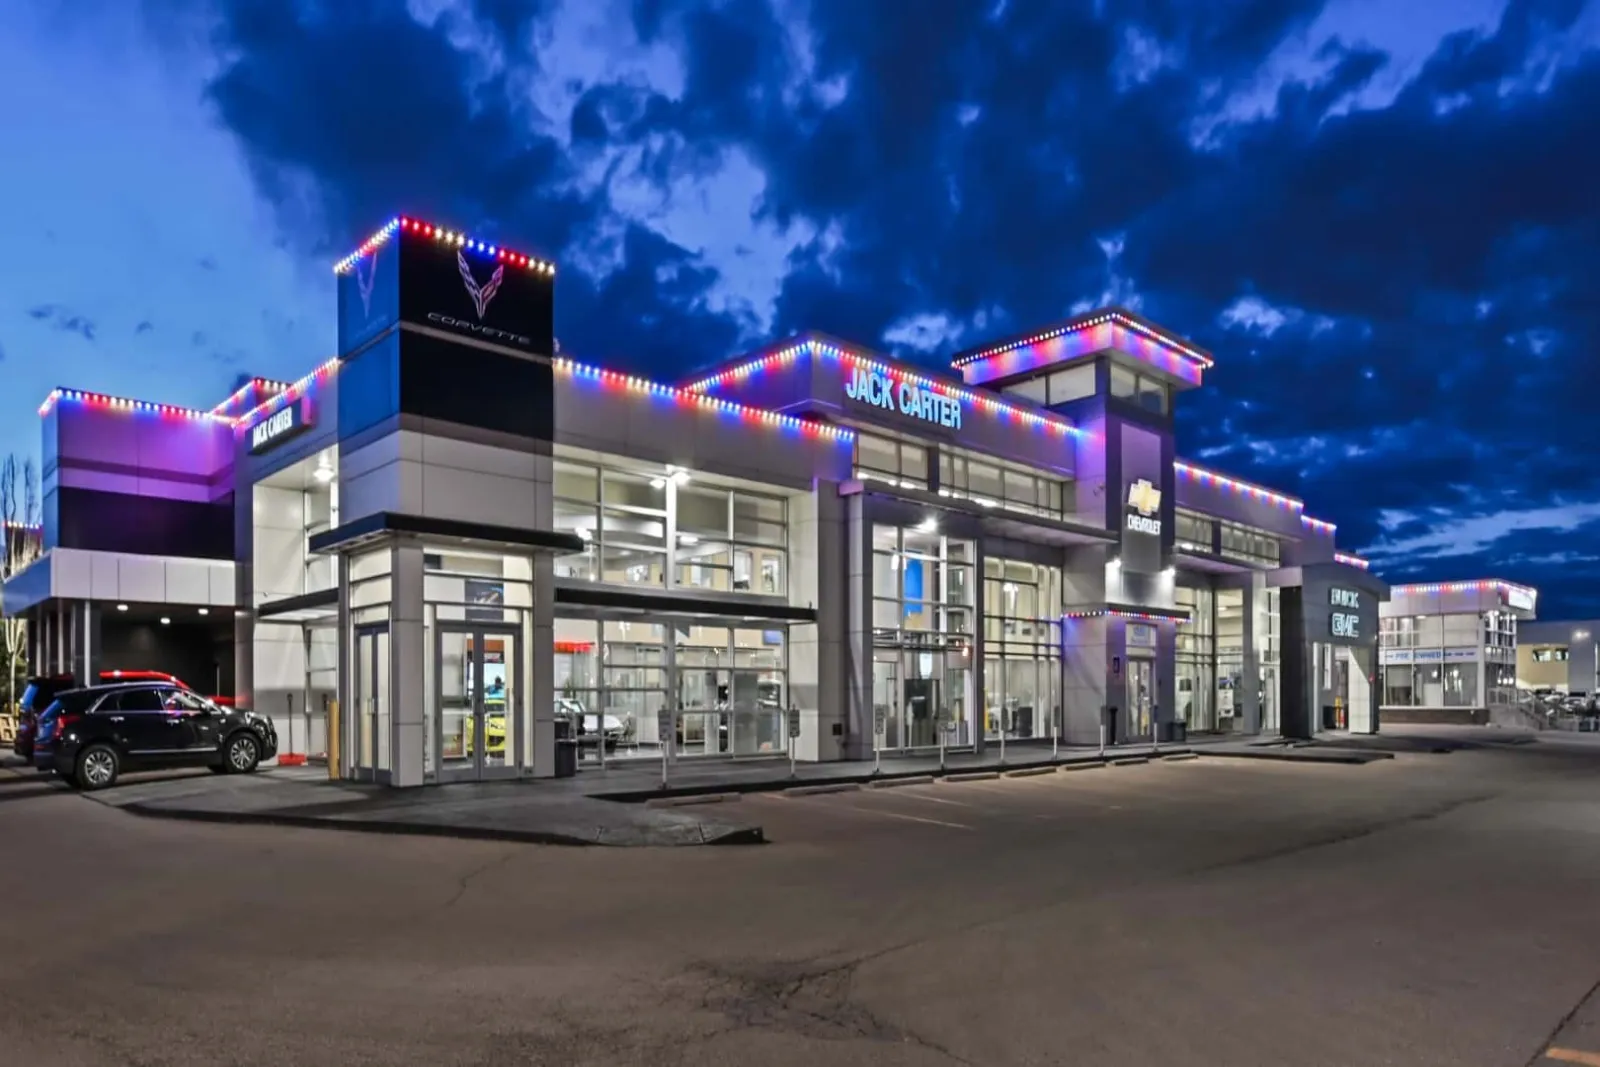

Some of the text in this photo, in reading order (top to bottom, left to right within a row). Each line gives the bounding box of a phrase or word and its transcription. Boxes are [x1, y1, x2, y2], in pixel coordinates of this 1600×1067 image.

[427, 311, 530, 345] CORVETTE
[845, 366, 961, 430] JACK CARTER
[252, 405, 293, 448] JACK CARTER
[1127, 513, 1161, 535] CHEVROLET
[1331, 588, 1359, 609] BUICK
[1332, 612, 1359, 638] GMC
